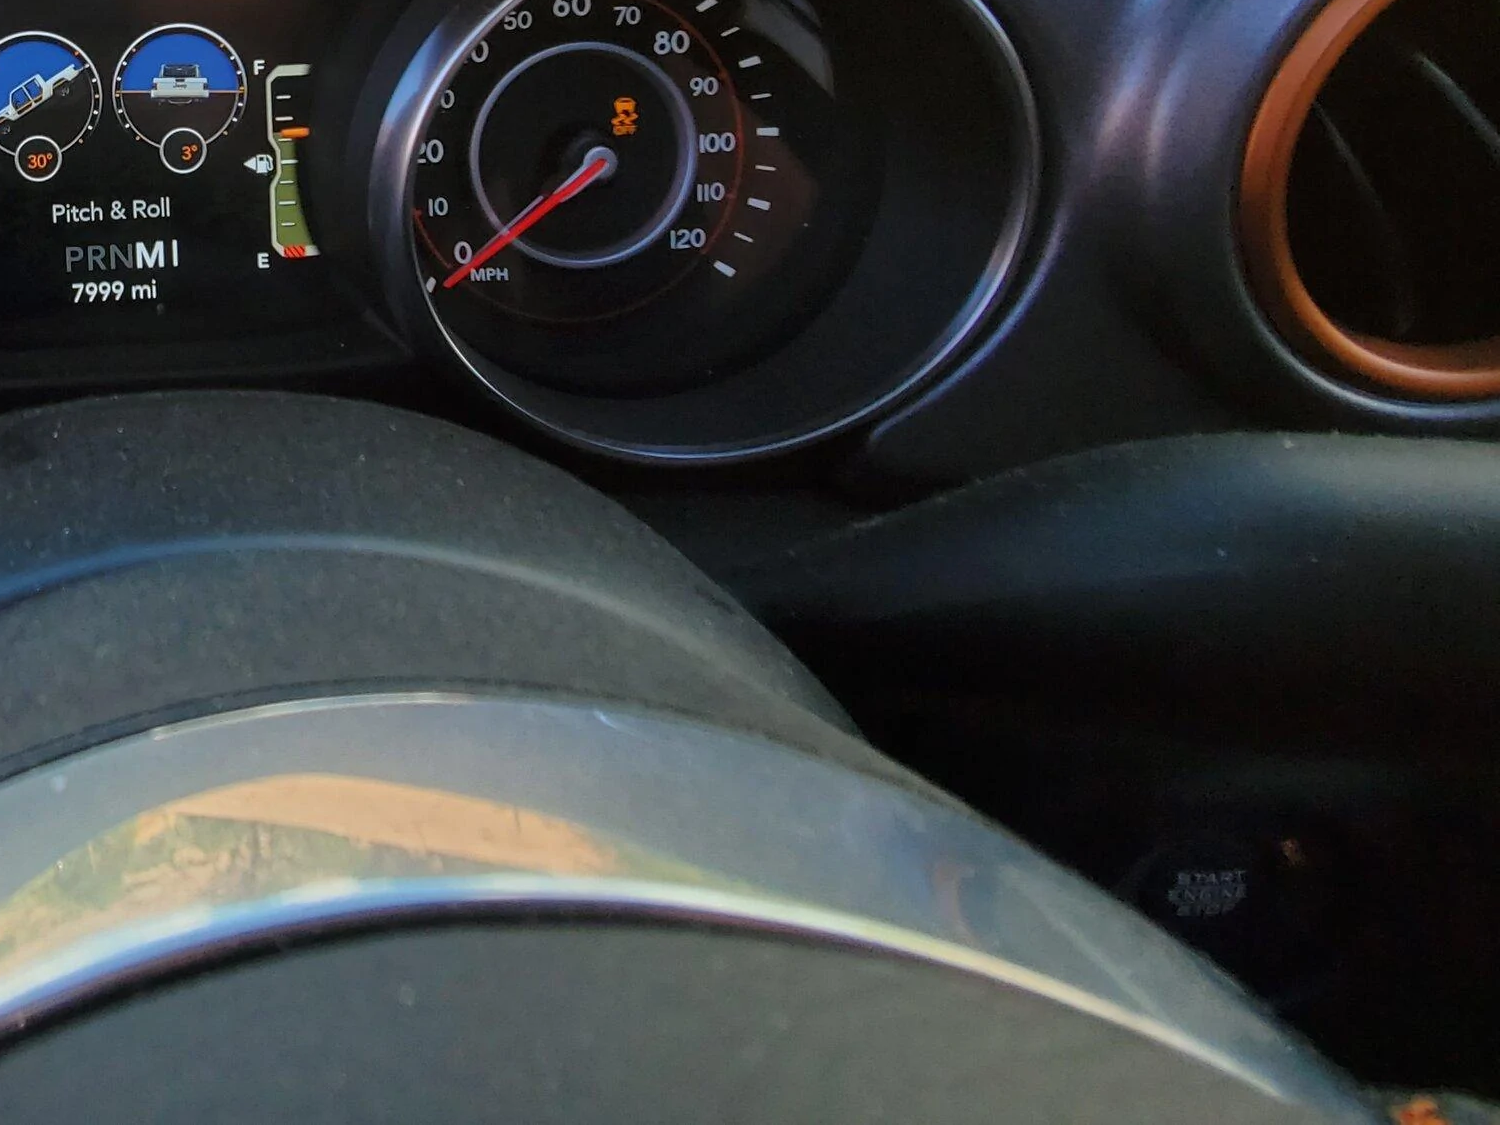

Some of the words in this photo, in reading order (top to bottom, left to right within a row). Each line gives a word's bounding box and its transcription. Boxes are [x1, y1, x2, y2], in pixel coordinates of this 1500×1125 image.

[503, 10, 533, 31] 50
[613, 6, 642, 26] 70
[653, 29, 691, 55] 80
[253, 59, 265, 75] F
[689, 76, 720, 97] 90
[699, 131, 737, 154] 100
[27, 152, 53, 170] 30°
[696, 181, 726, 203] 110
[52, 200, 103, 224] Pitch
[110, 200, 126, 220] &
[132, 196, 171, 219] Roll
[428, 196, 449, 217] 10
[670, 228, 707, 250] 120
[257, 252, 270, 269] E
[453, 240, 473, 265] 0
[470, 267, 510, 282] MPH
[71, 280, 124, 304] 7999
[131, 278, 157, 300] mi
